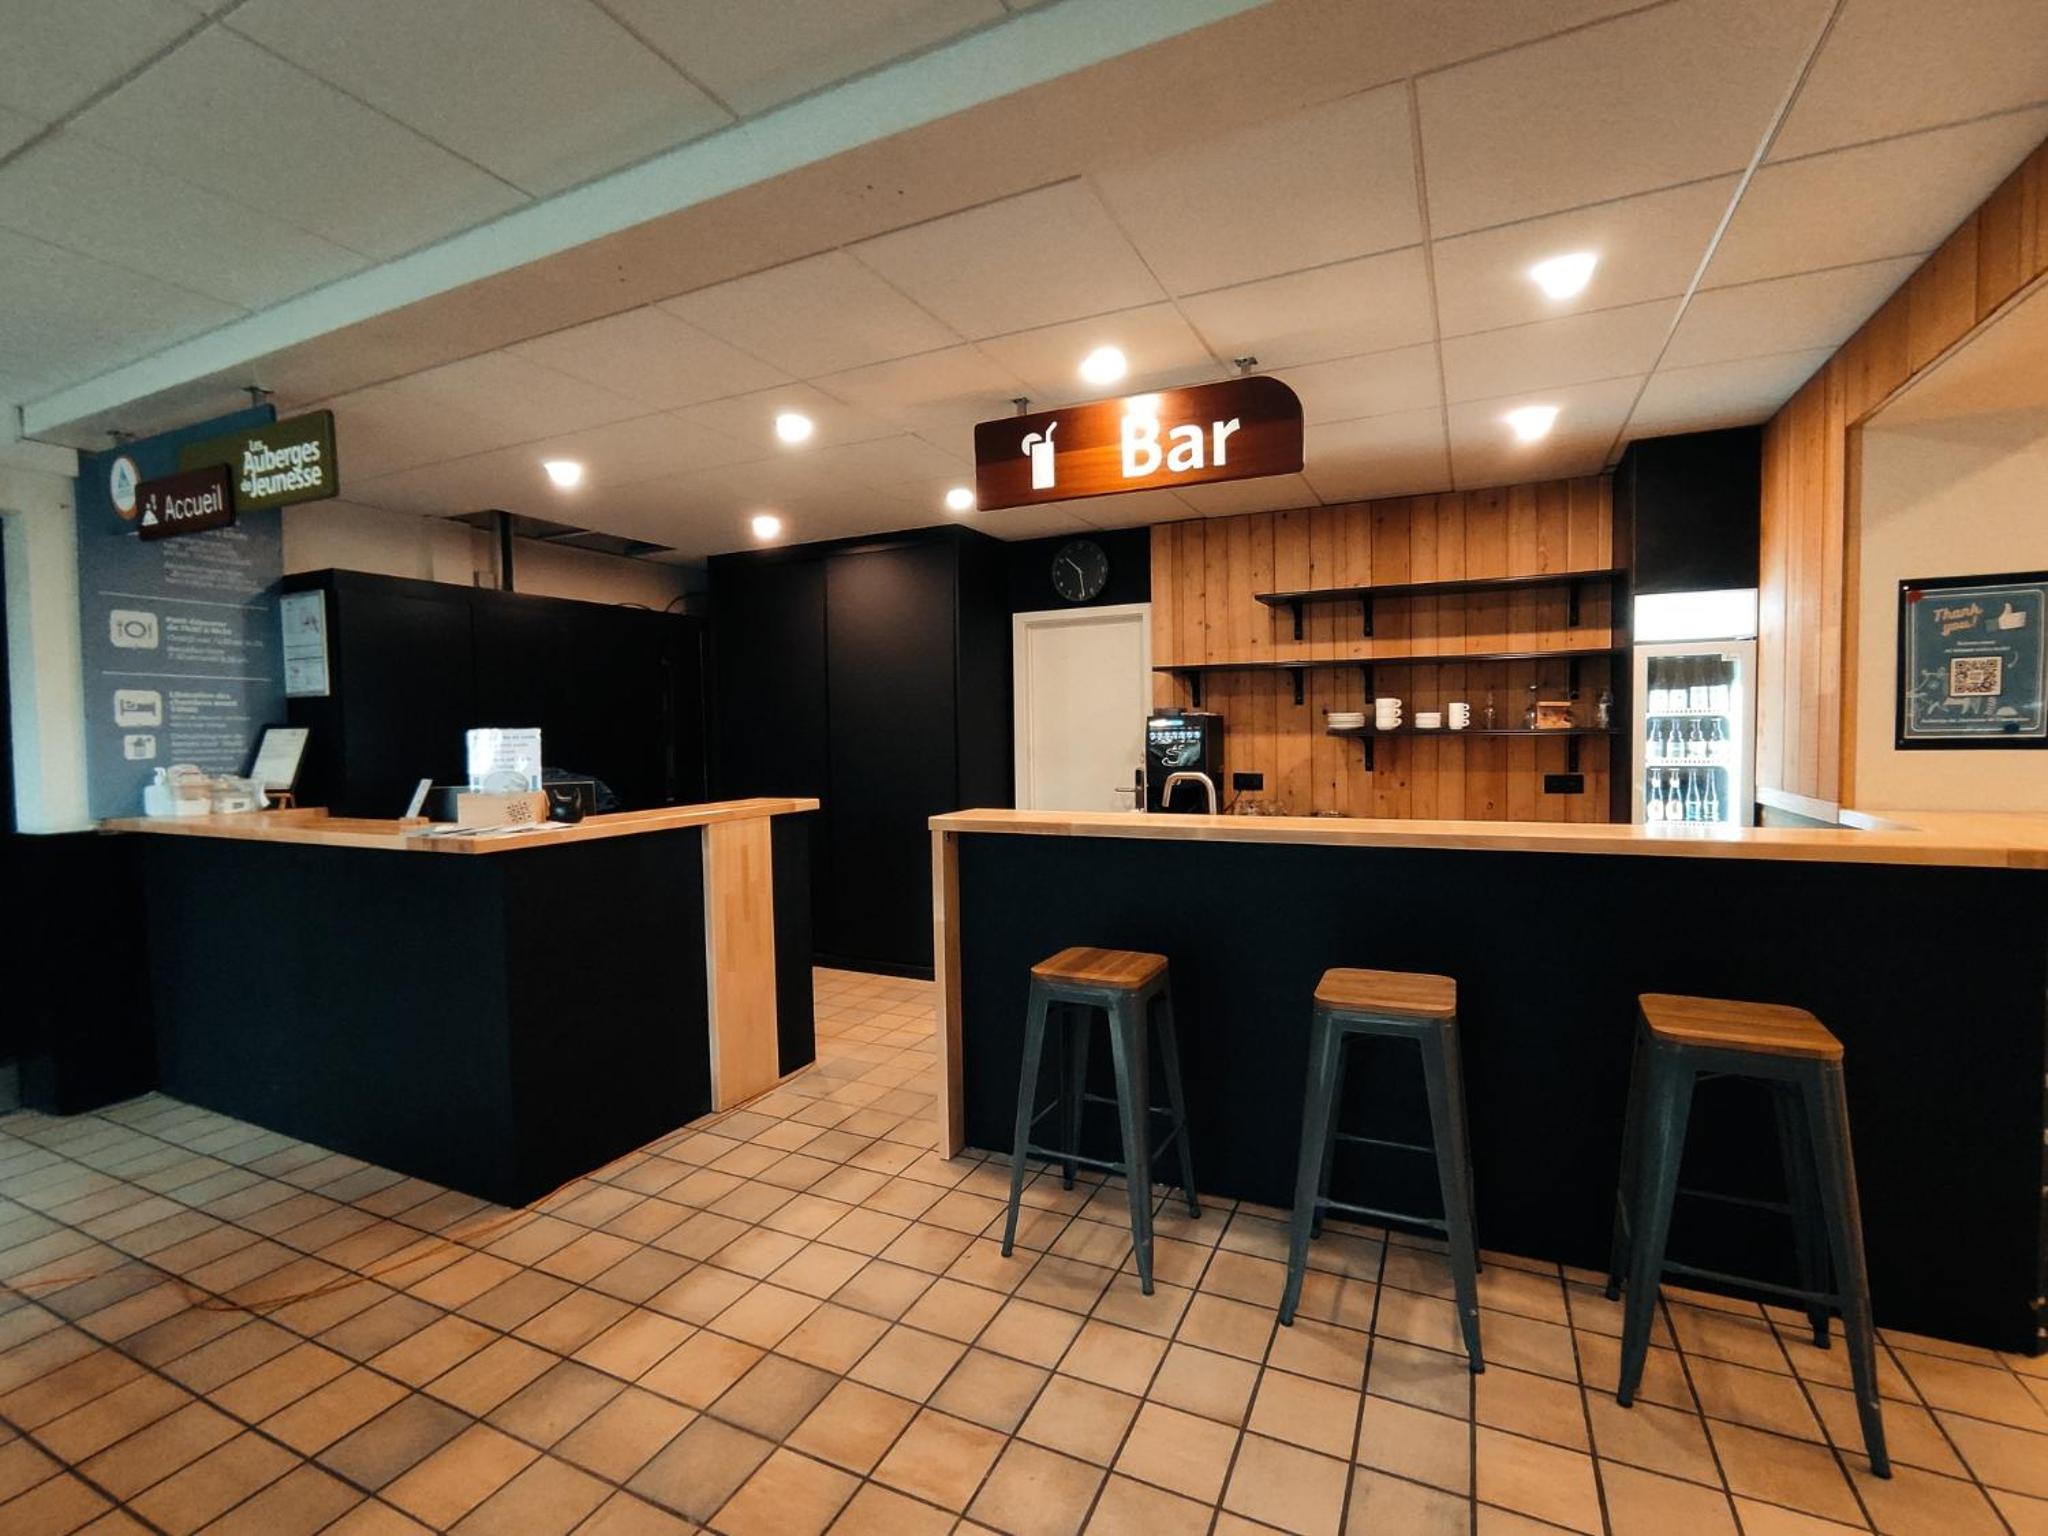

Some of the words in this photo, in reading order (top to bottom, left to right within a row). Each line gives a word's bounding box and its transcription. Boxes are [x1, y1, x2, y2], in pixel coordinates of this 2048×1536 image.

[243, 440, 321, 476] Auberges
[248, 439, 264, 452] Les
[1120, 411, 1240, 478] Bar
[250, 465, 322, 498] Jeunesse
[164, 484, 223, 522] Accueil
[1932, 602, 1984, 622] Thank
